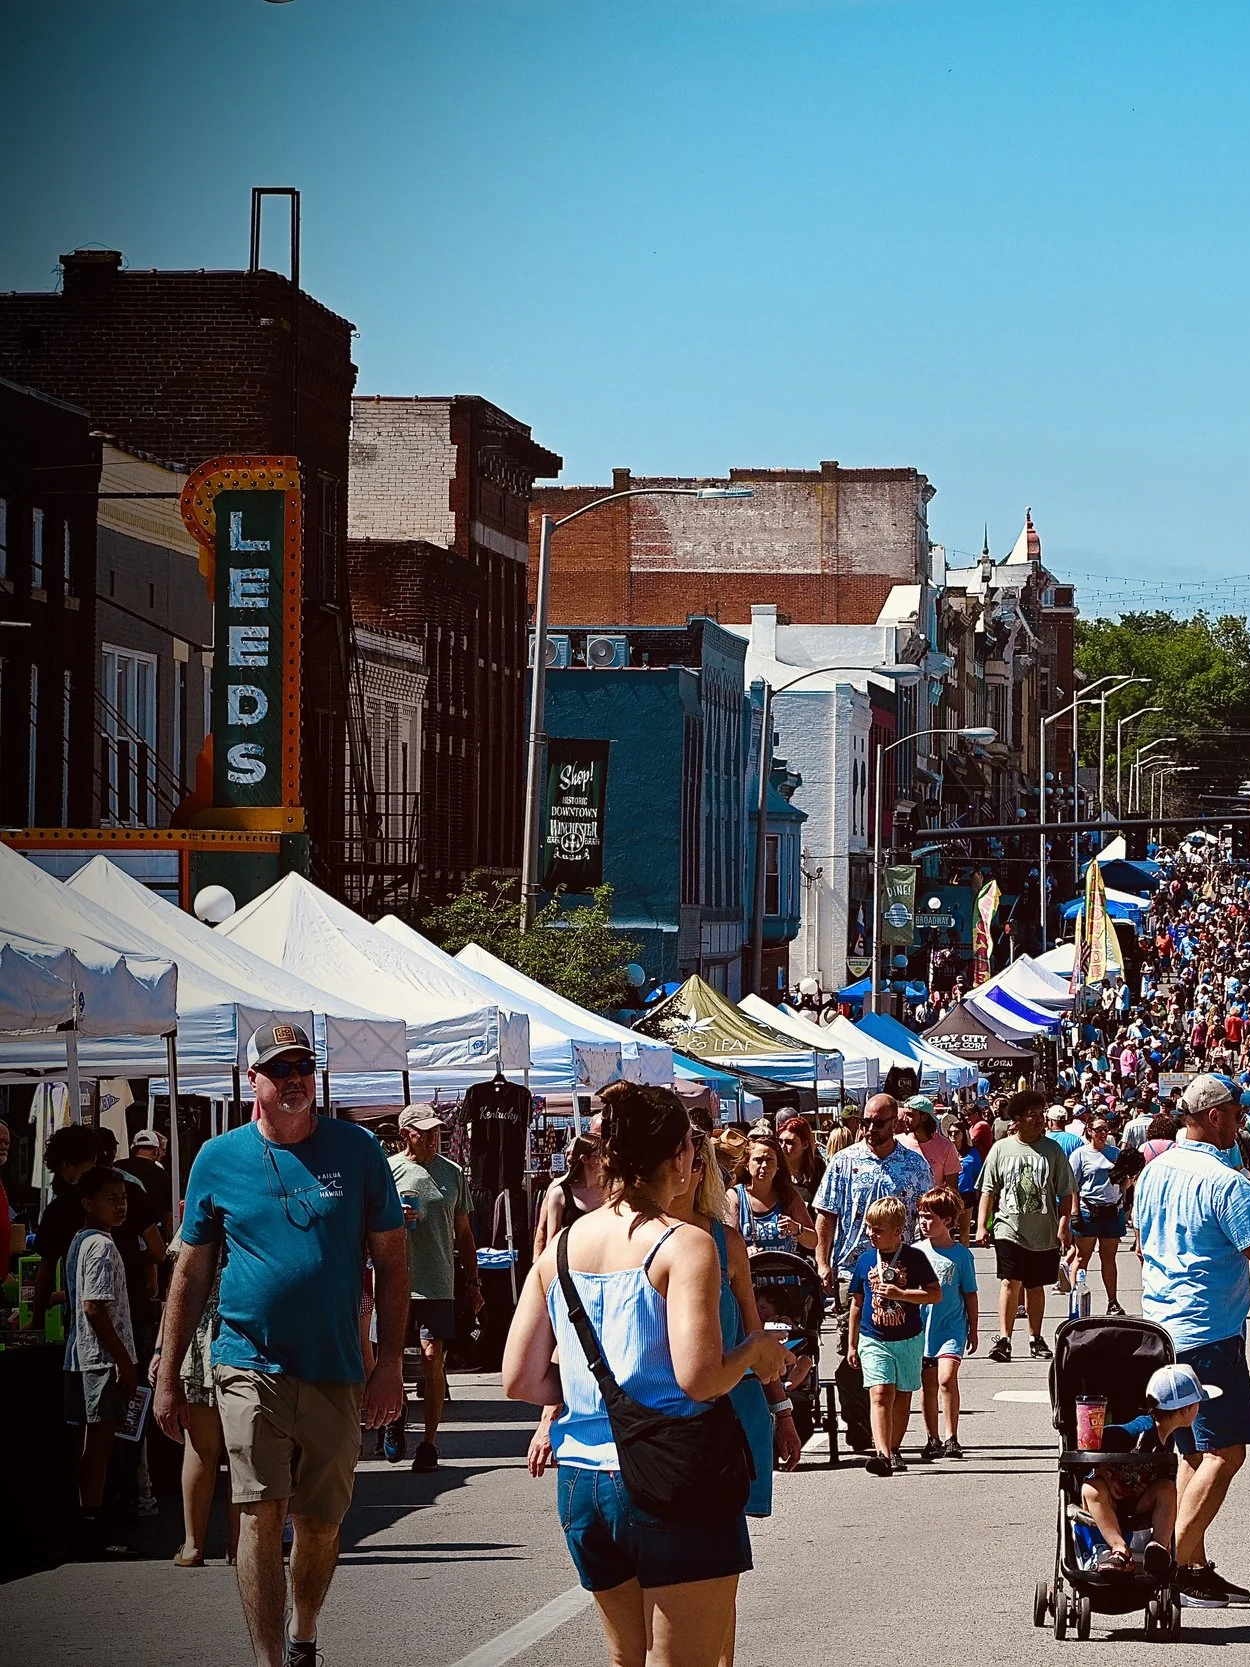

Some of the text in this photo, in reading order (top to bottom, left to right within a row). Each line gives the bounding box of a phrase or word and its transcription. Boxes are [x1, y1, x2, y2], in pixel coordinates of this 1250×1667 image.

[227, 511, 271, 784] LEEDS
[559, 761, 594, 792] Shop!
[562, 796, 588, 805] HISTORIC
[551, 806, 598, 818] DOWNTOWN
[550, 819, 598, 838] WINCHESTER
[886, 885, 911, 897] DINE!
[915, 916, 950, 925] BROADWAY
[686, 1036, 753, 1052] & LEAF
[961, 1034, 988, 1043] CITY
[930, 1042, 961, 1050] TTLE
[962, 1042, 988, 1050] CORN
[480, 1105, 519, 1124] Kentucky
[320, 1190, 344, 1198] HAWAII
